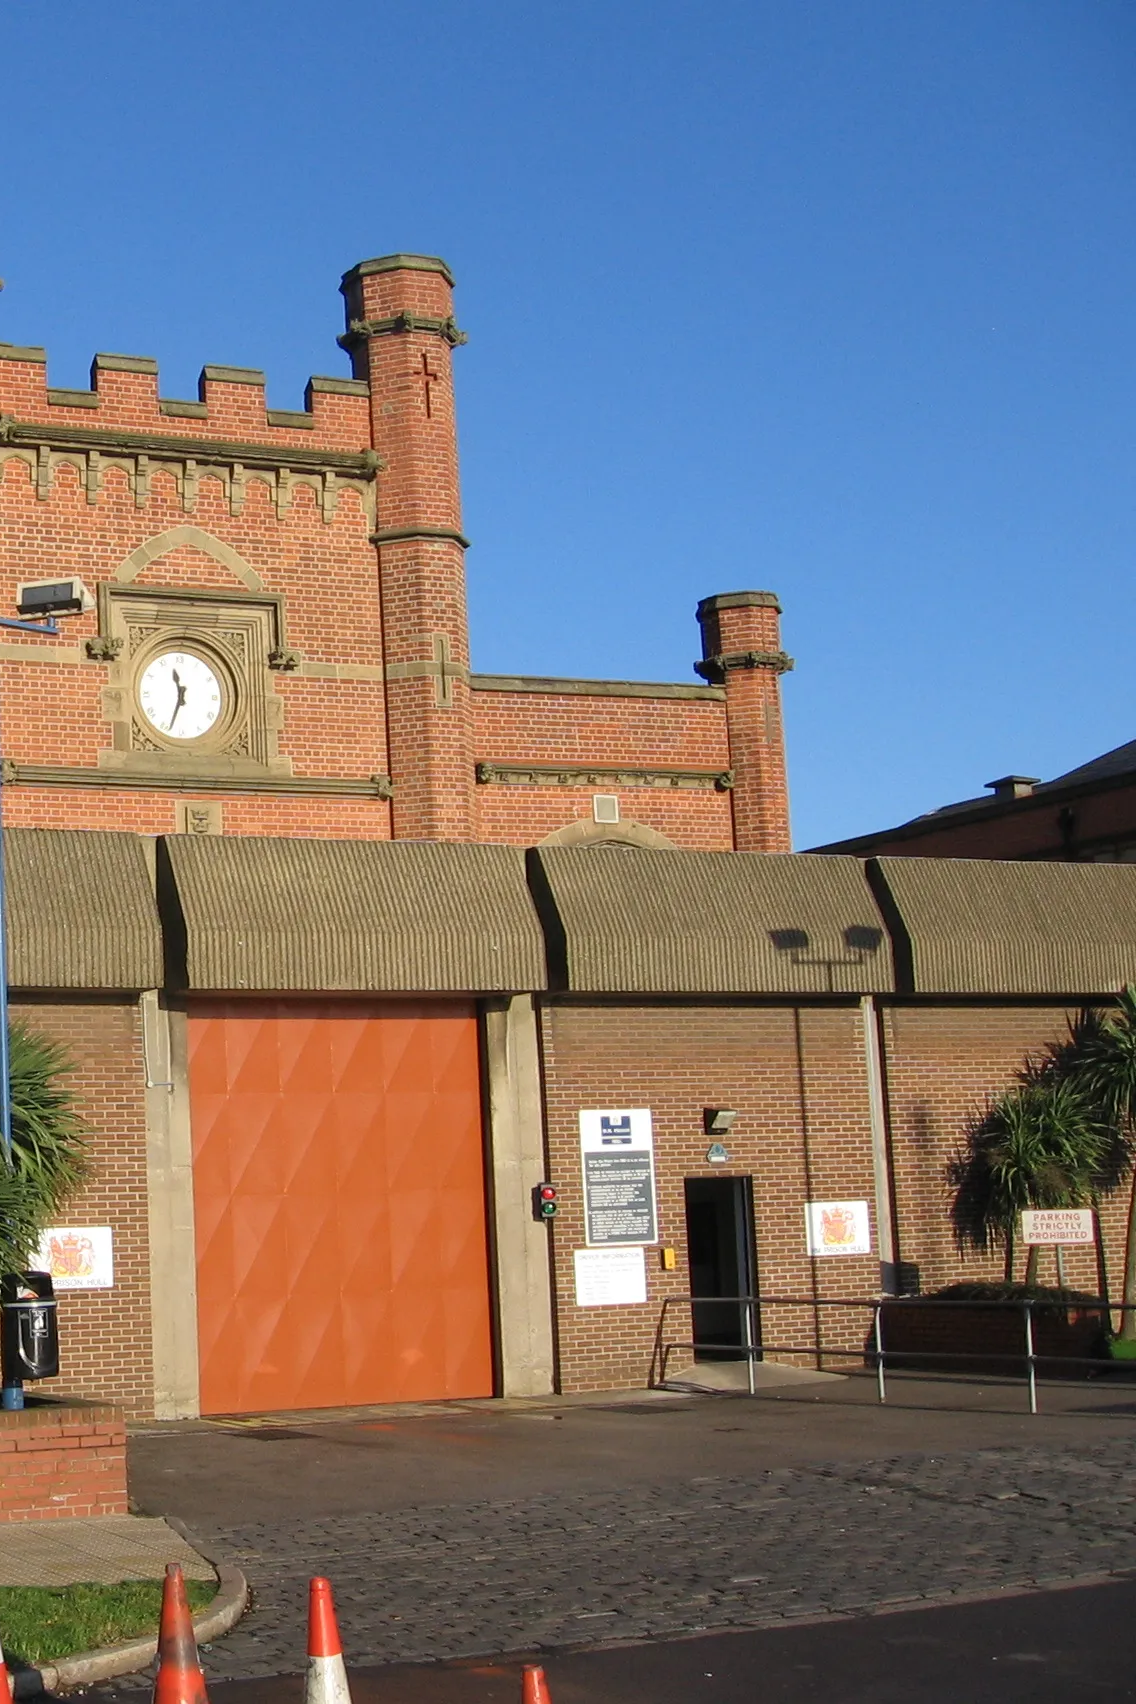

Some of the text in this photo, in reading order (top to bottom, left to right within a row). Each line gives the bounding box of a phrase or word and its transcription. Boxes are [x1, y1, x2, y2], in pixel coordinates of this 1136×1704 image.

[1033, 1213, 1081, 1221] PARKING
[1032, 1222, 1082, 1230] STRICTLY
[1028, 1231, 1087, 1240] PROHIBITED
[87, 1278, 108, 1286] HULL
